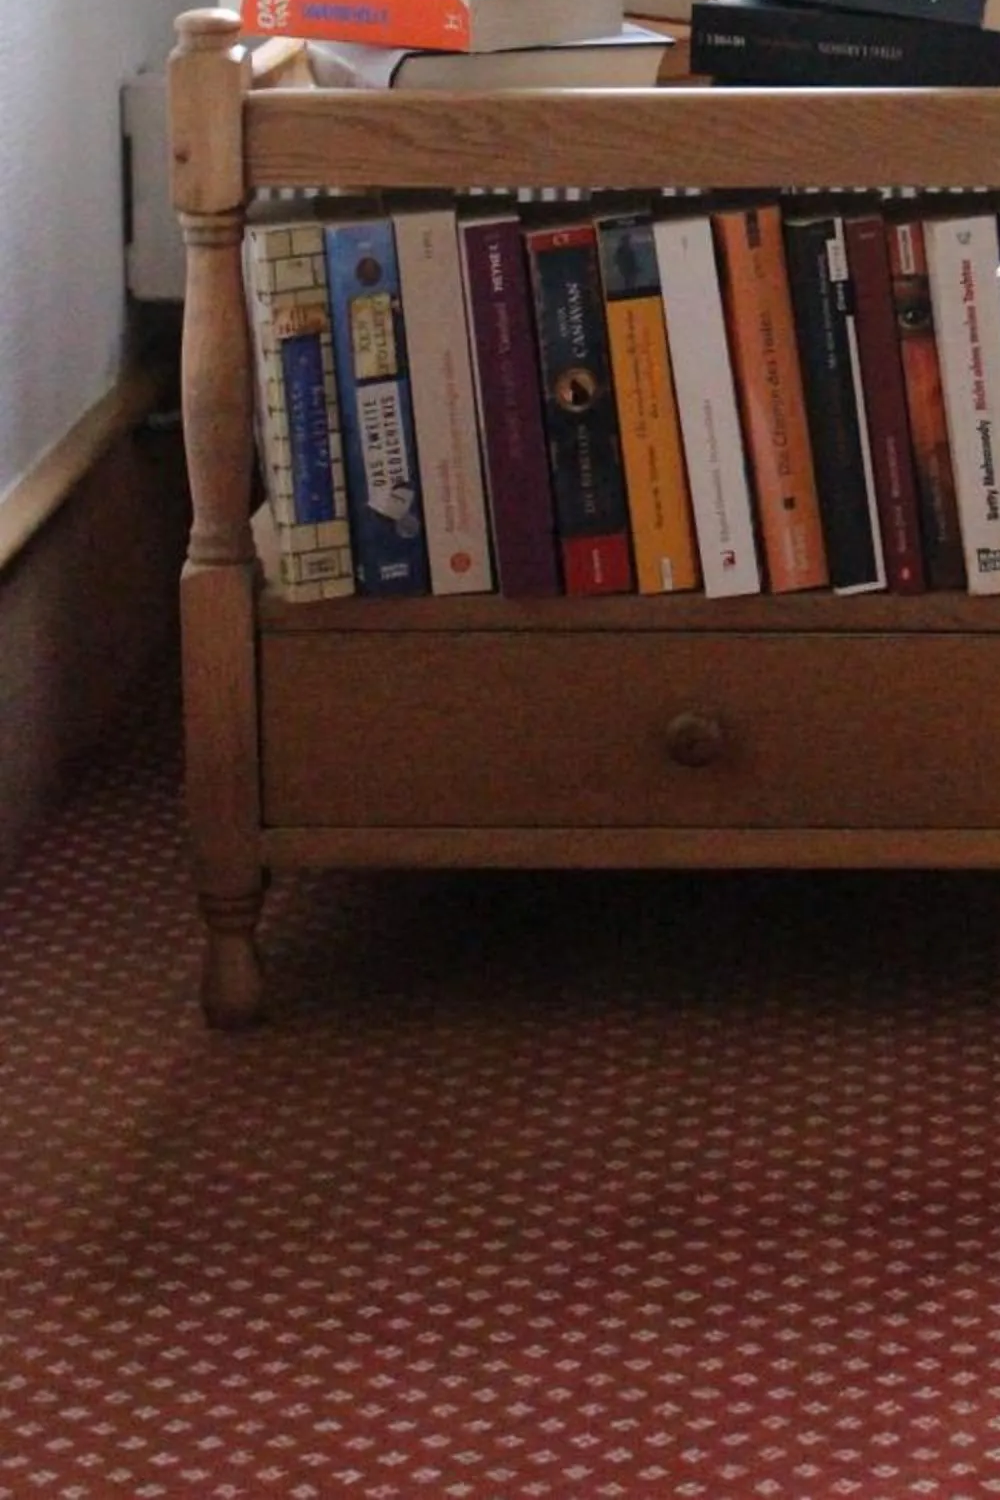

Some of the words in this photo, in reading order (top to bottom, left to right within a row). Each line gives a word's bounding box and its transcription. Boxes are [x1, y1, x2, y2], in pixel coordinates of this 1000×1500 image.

[566, 281, 588, 359] CANAVAN
[362, 396, 383, 452] ZWEITE
[370, 460, 386, 489] DAS
